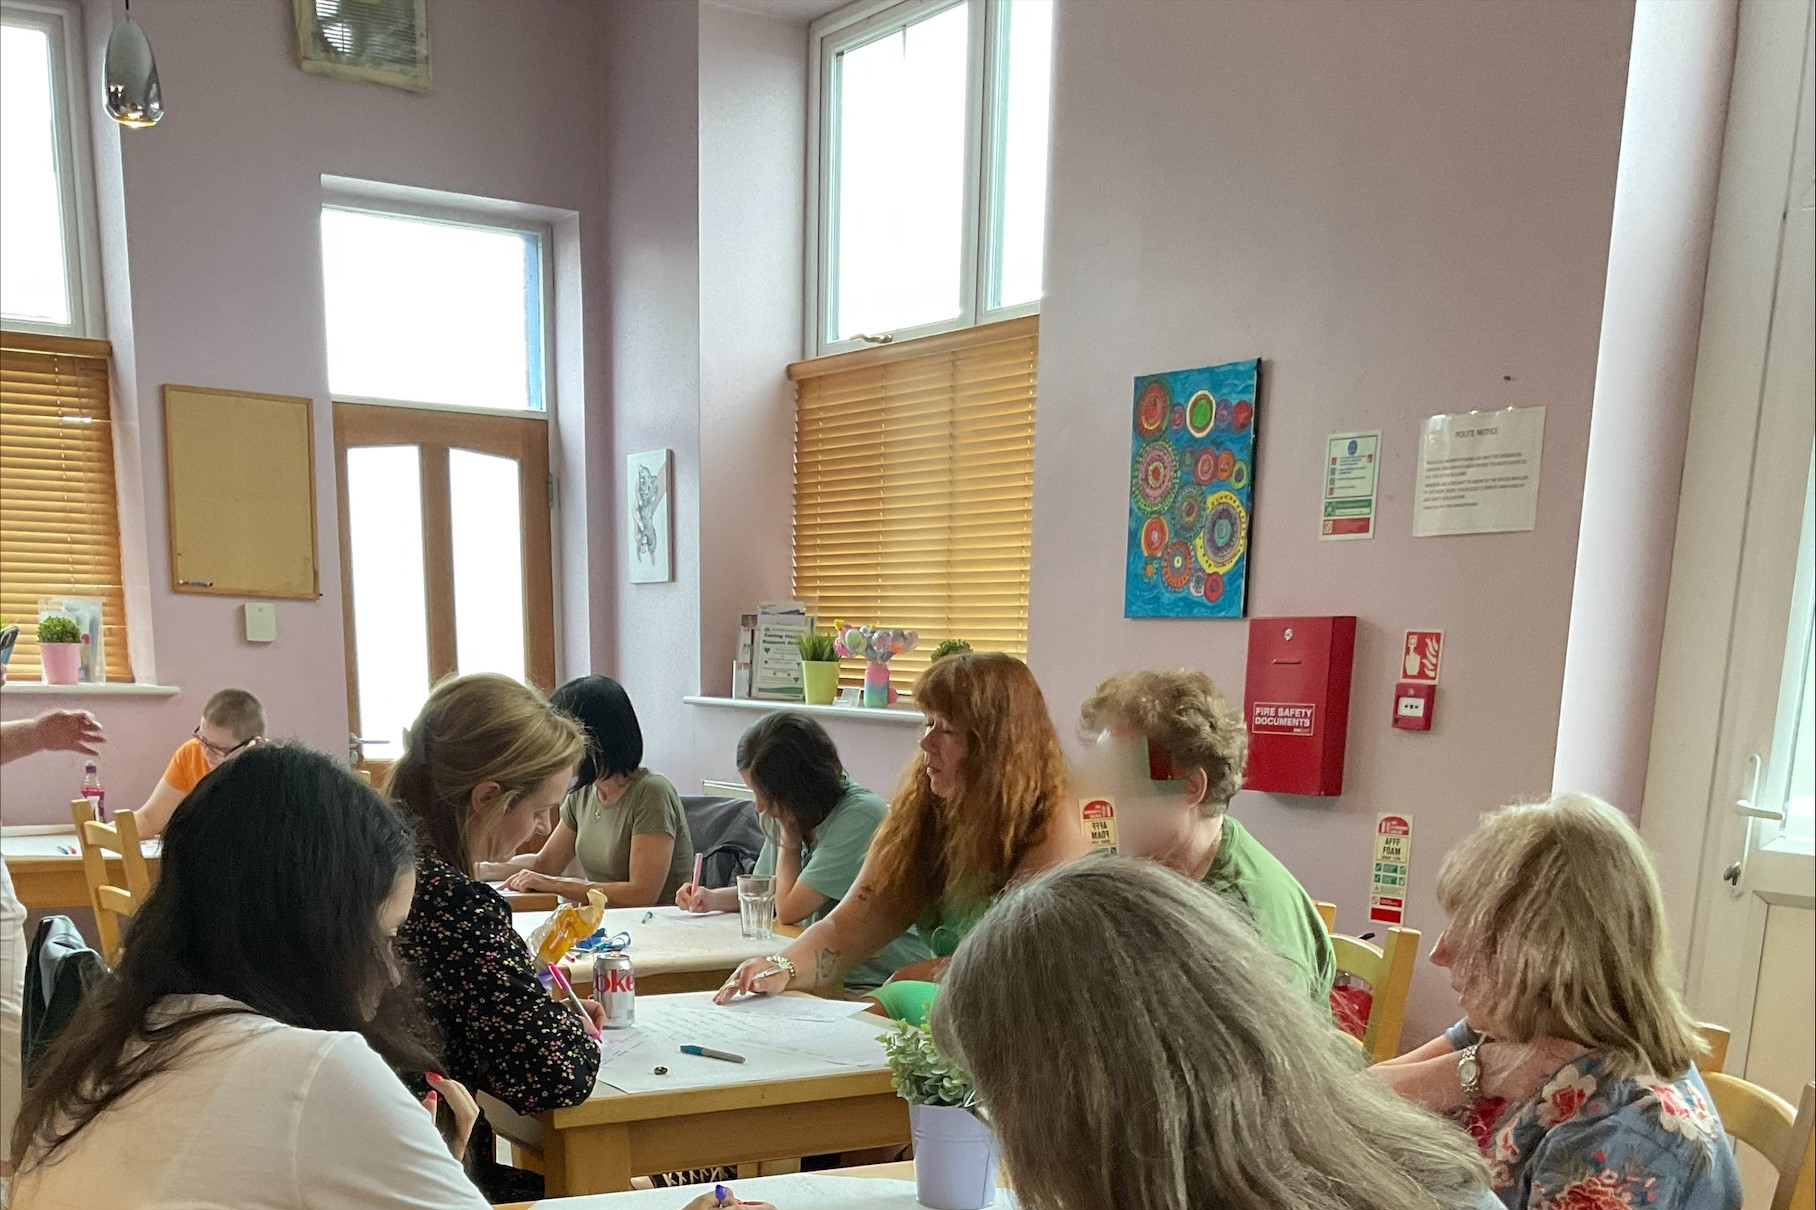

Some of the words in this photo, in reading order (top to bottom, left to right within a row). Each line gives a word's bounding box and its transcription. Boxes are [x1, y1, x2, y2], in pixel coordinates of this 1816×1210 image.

[1455, 429, 1476, 438] POLITE
[1477, 427, 1499, 436] NOTICE
[1255, 707, 1276, 716] FIRE
[1278, 708, 1312, 717] SAFETY
[1255, 717, 1310, 727] DOCUMENTS
[1384, 837, 1400, 846] AFFF
[1382, 846, 1401, 855] FOAM
